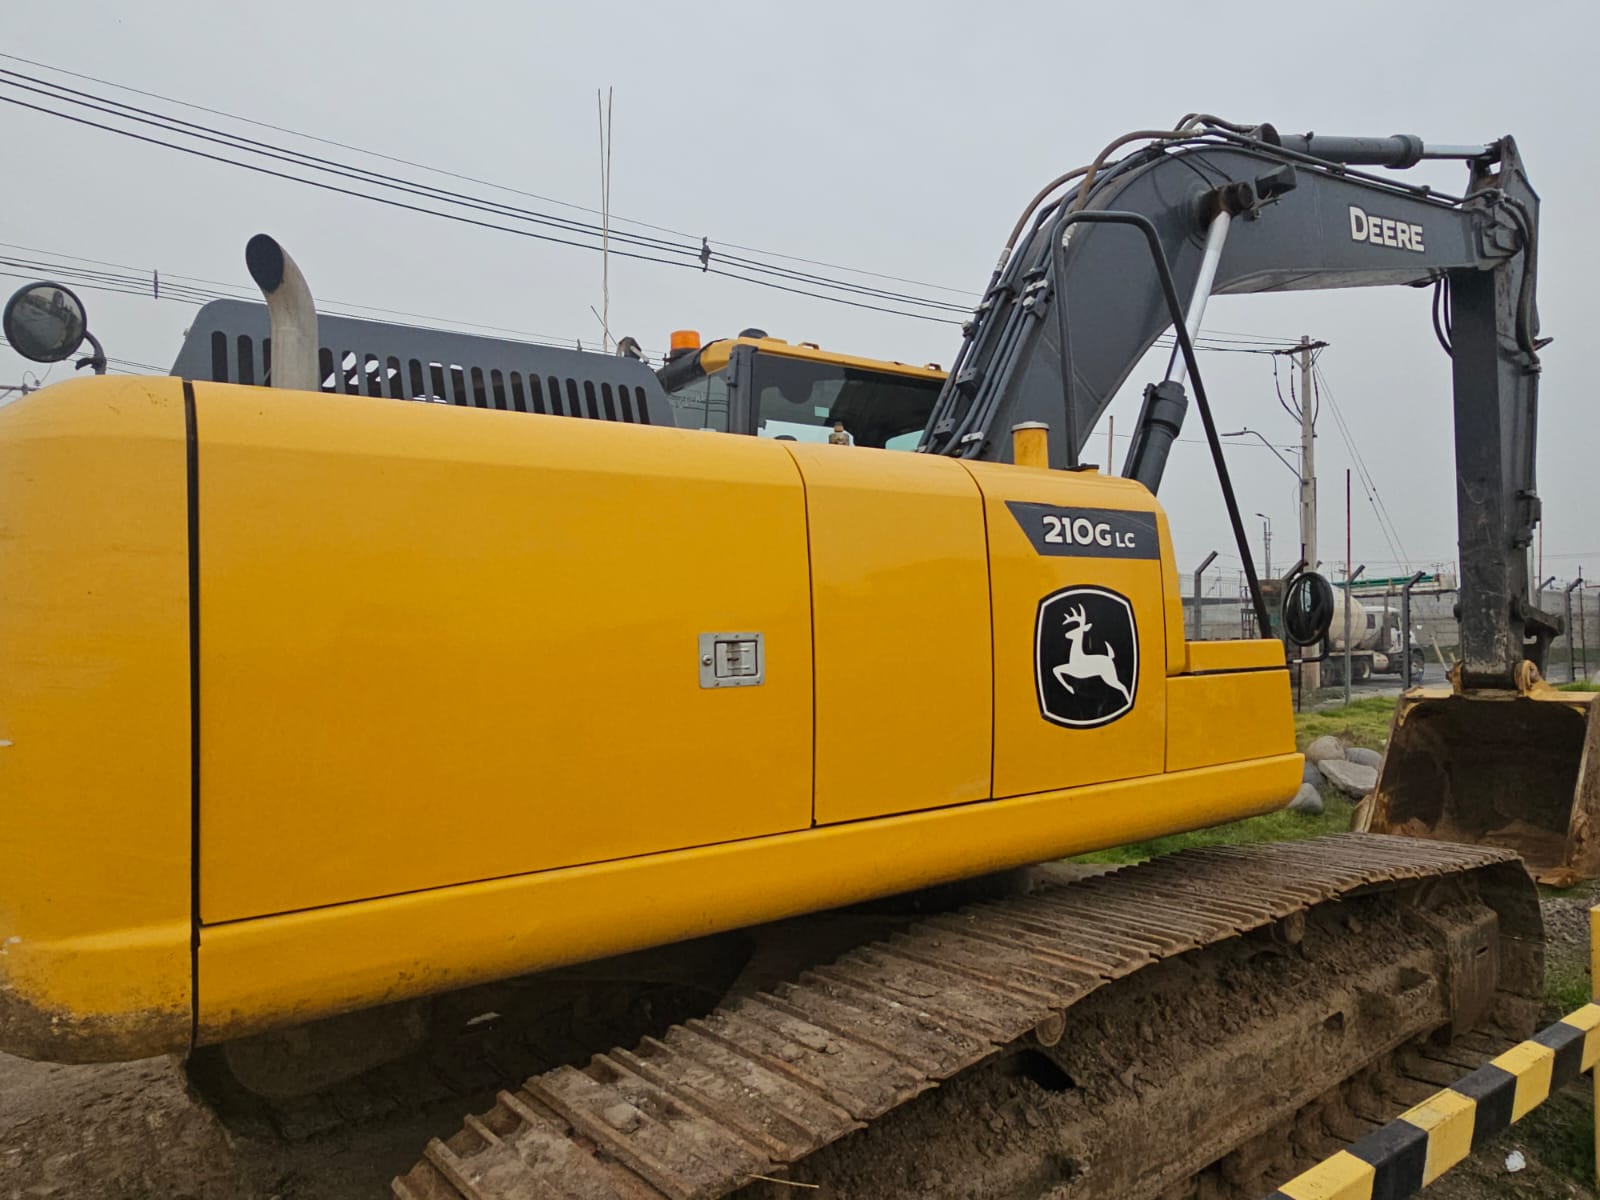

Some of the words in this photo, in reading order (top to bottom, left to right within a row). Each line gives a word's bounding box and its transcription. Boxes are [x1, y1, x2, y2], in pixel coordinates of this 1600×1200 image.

[1349, 206, 1425, 252] DEERE
[1042, 515, 1112, 547] 210G
[1115, 532, 1136, 548] LC
